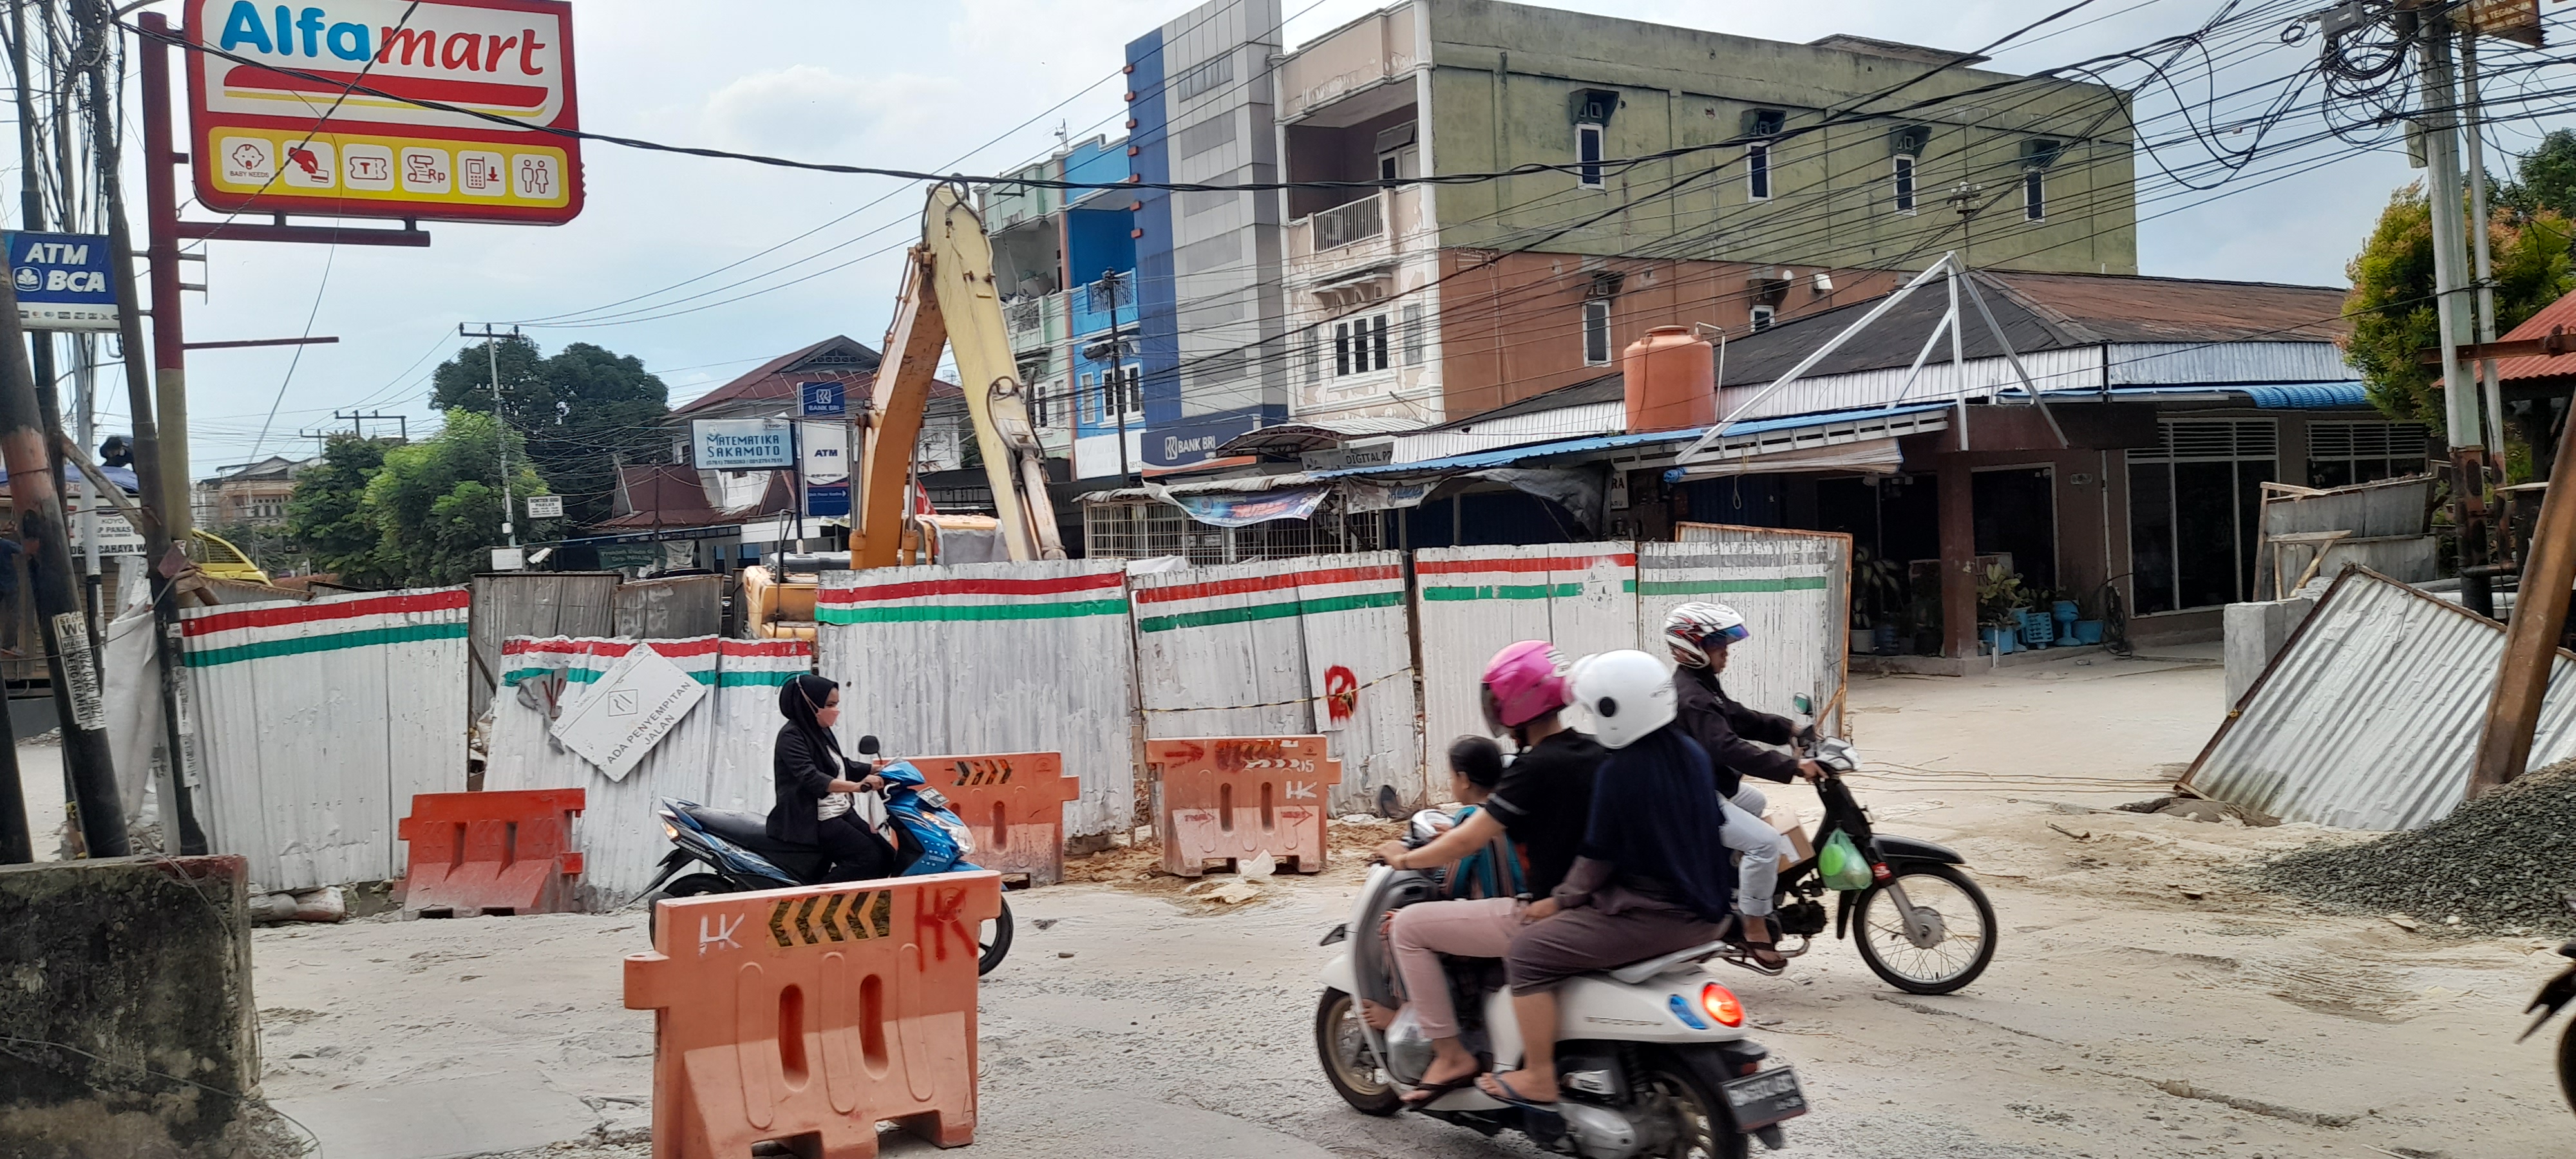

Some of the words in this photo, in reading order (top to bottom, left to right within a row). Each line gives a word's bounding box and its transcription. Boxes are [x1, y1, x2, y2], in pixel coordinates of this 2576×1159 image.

[220, 0, 546, 75] Alfamart
[428, 169, 446, 181] Rp
[24, 242, 89, 265] ATM
[46, 270, 106, 292] BCA
[706, 434, 779, 446] MATEMATIKA
[1177, 437, 1202, 454] BANK
[1202, 435, 1216, 450] BRI
[708, 446, 780, 458] SAKAMOTO
[814, 449, 838, 457] ATM
[1346, 452, 1381, 464] DIGITAL
[98, 544, 134, 554] CAHAYA
[62, 622, 85, 636] WC
[607, 744, 629, 765] ADA
[627, 681, 692, 744] PENYEMPITAN
[645, 714, 675, 745] JALAN
[1285, 780, 1318, 800] HK
[699, 912, 745, 956] HK
